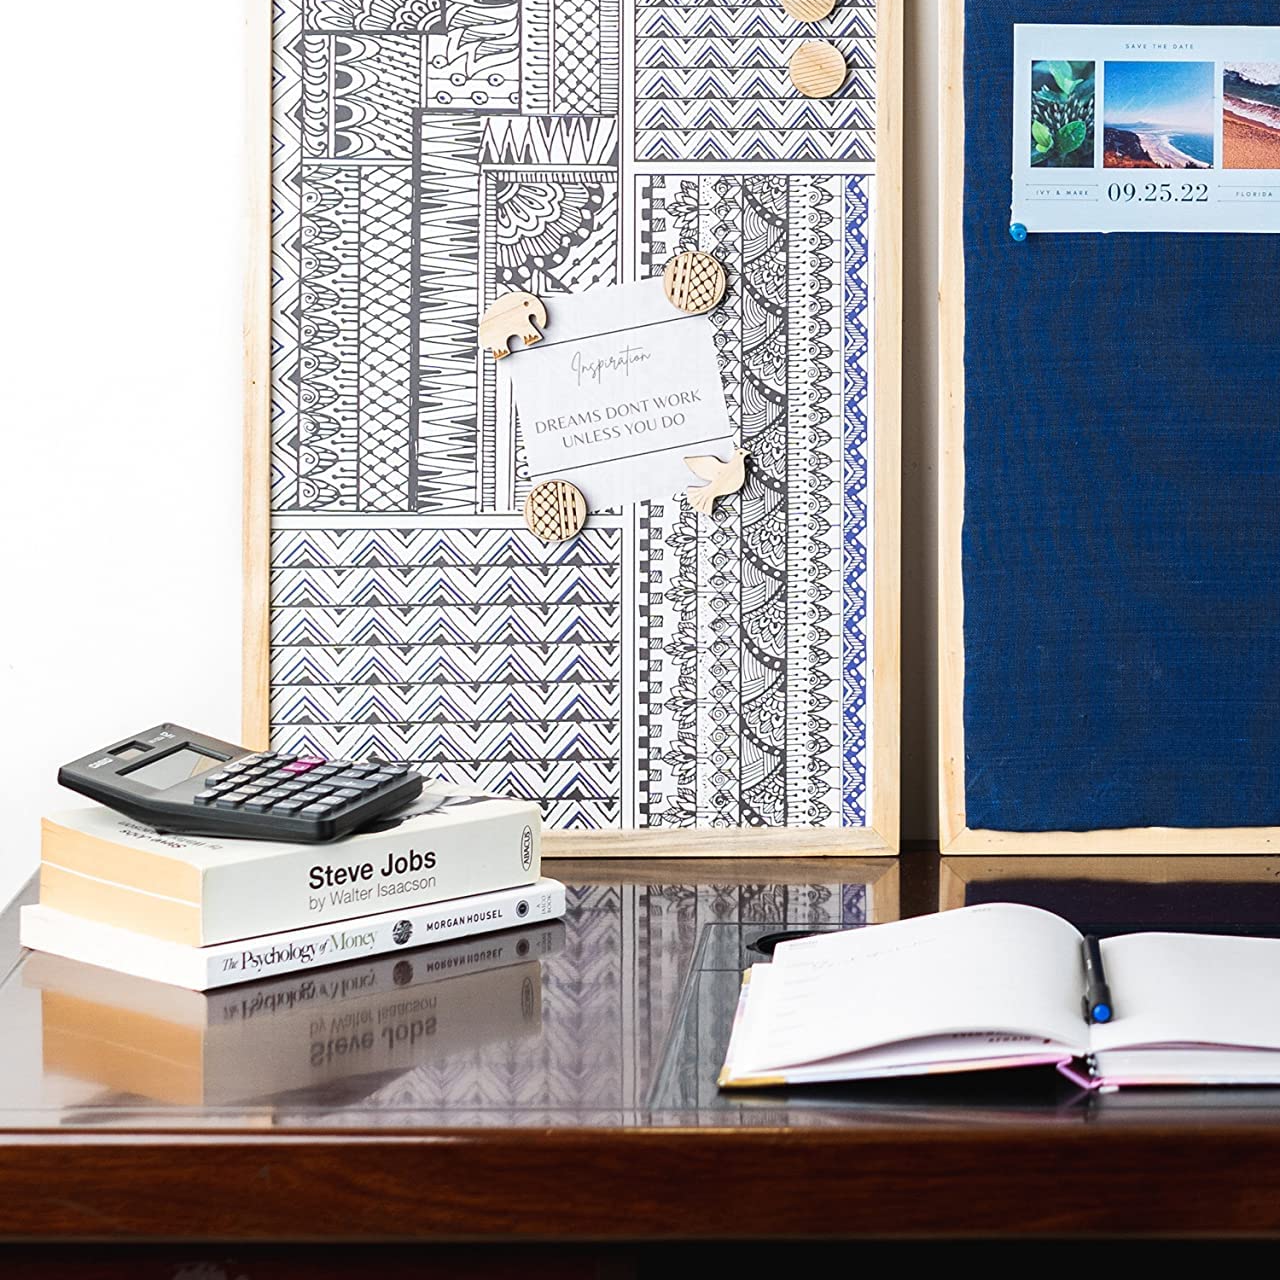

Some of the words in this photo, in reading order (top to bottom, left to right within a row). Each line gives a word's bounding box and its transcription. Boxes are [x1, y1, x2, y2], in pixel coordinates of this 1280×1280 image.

[1107, 182, 1209, 203] 09.25.22
[570, 345, 651, 386] Inspiration
[535, 410, 601, 434] DREAMS
[606, 400, 649, 420] DONT
[654, 389, 702, 410] WORK
[562, 425, 621, 449] UNLESS
[624, 418, 657, 437] YOU
[662, 413, 685, 428] DO
[523, 831, 531, 865] ABACUS
[309, 861, 374, 890] Steve
[381, 849, 437, 877] Jobs
[309, 895, 326, 913] by
[329, 888, 373, 907] Walter
[377, 874, 437, 898] Isaacson
[426, 916, 465, 932] MORGAN
[467, 909, 503, 924] HOUSEL
[222, 958, 239, 971] The
[241, 942, 317, 972] Psychology
[319, 939, 330, 955] of
[330, 930, 378, 951] Money
